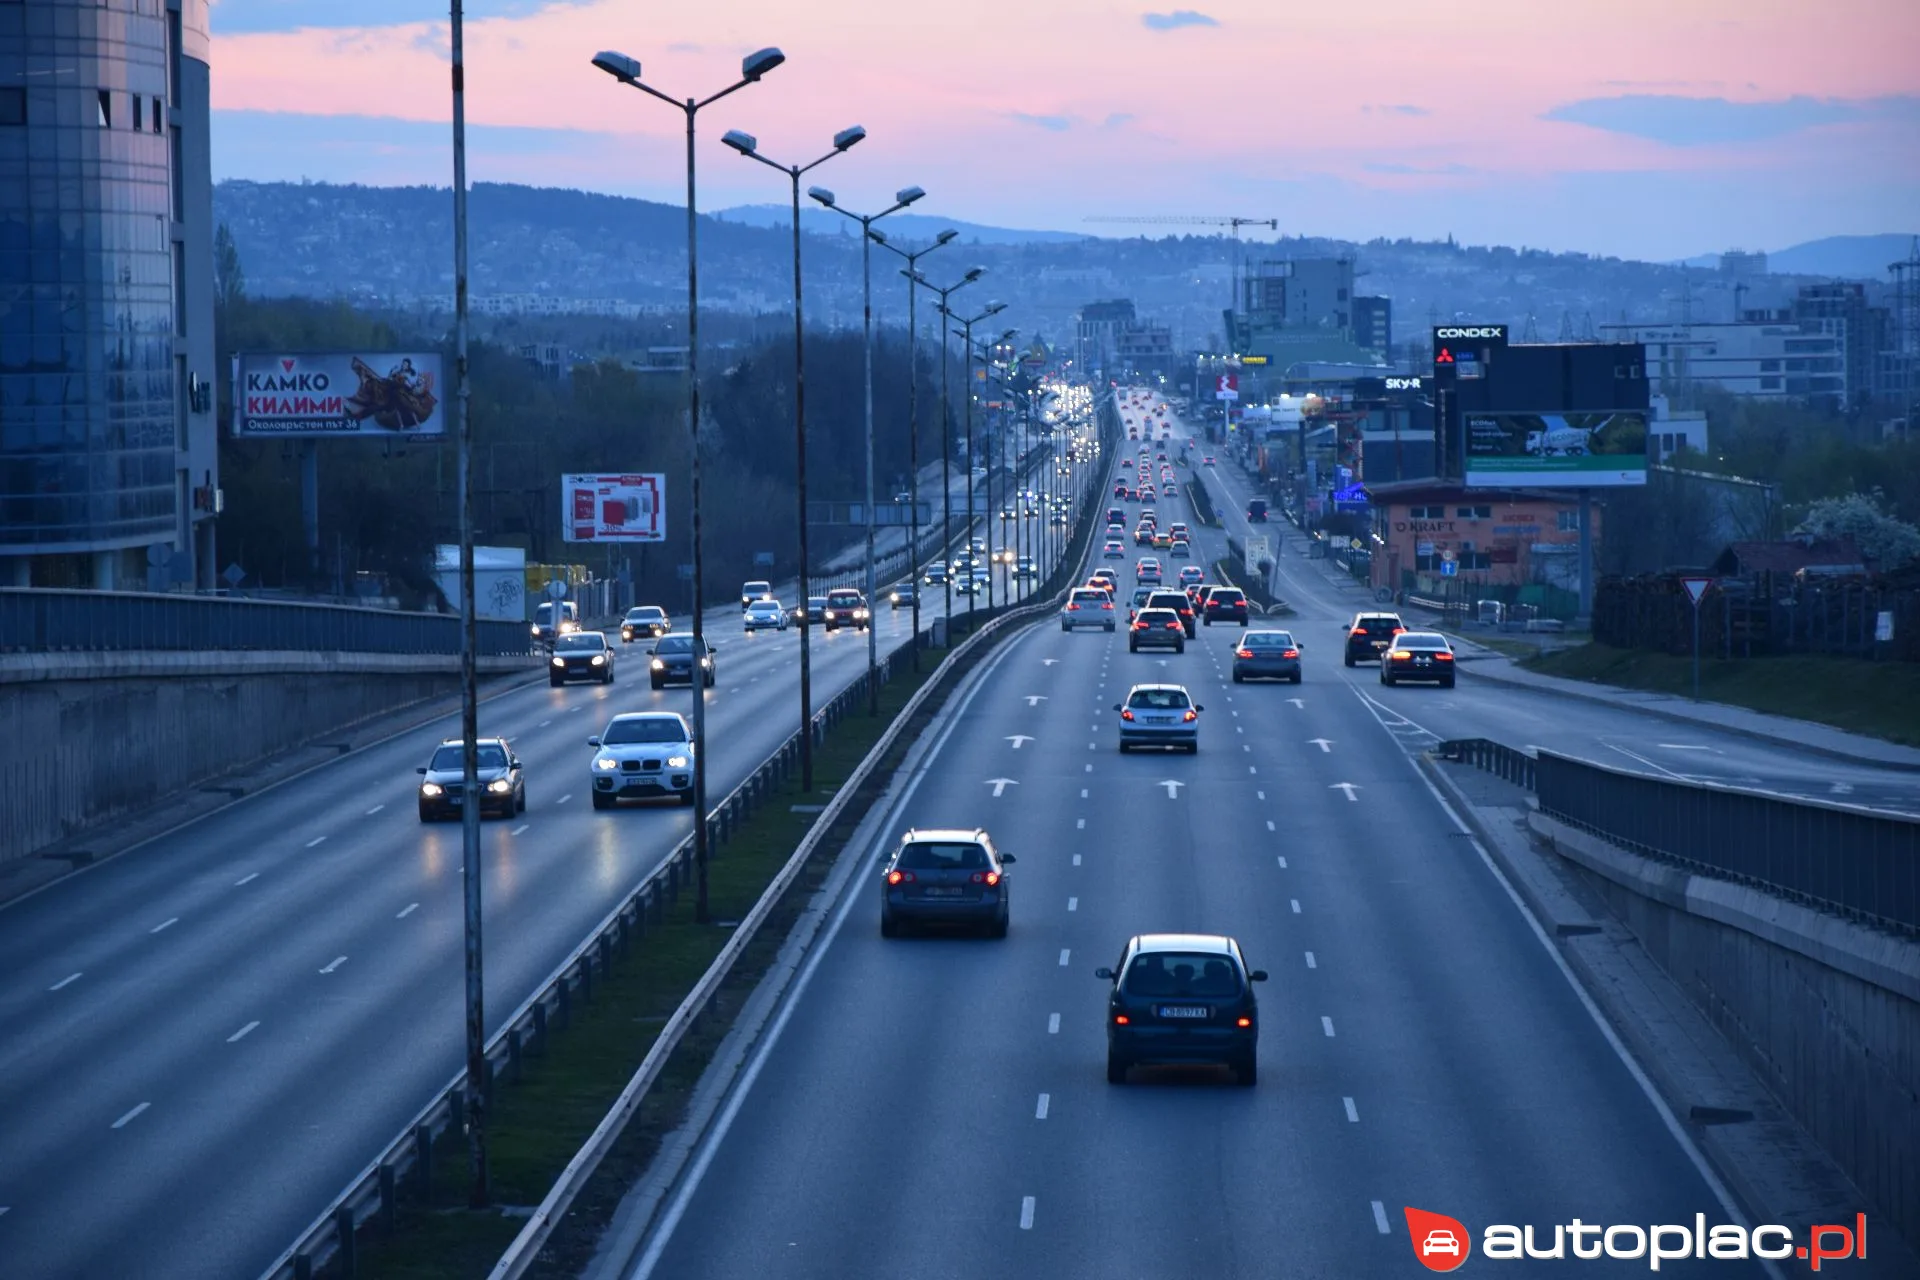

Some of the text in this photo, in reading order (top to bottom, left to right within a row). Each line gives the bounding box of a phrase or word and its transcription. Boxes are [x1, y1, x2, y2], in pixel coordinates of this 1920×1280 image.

[1437, 327, 1502, 339] CONDEX
[248, 374, 329, 391] КАМКО
[248, 397, 341, 414] КИЛИМИ
[247, 419, 324, 431] Околовръстен
[326, 421, 343, 430] път
[1409, 521, 1456, 533] KRAFT
